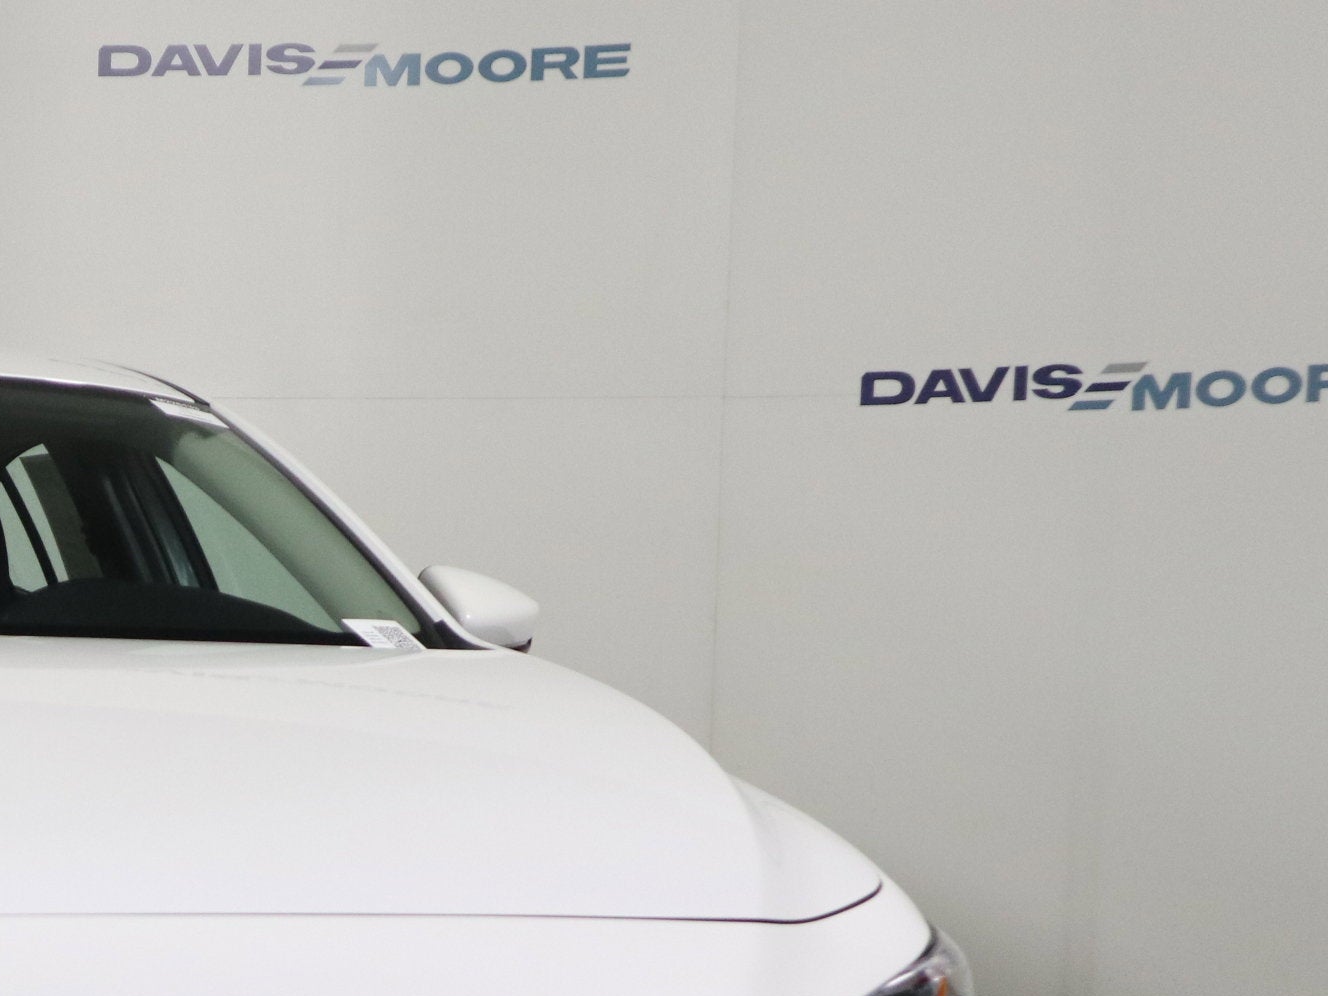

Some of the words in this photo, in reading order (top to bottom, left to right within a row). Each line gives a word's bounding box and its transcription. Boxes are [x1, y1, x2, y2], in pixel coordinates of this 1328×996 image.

[98, 43, 315, 77] DAVIS
[364, 43, 631, 87] MOORE
[859, 364, 1083, 406] DAVIS
